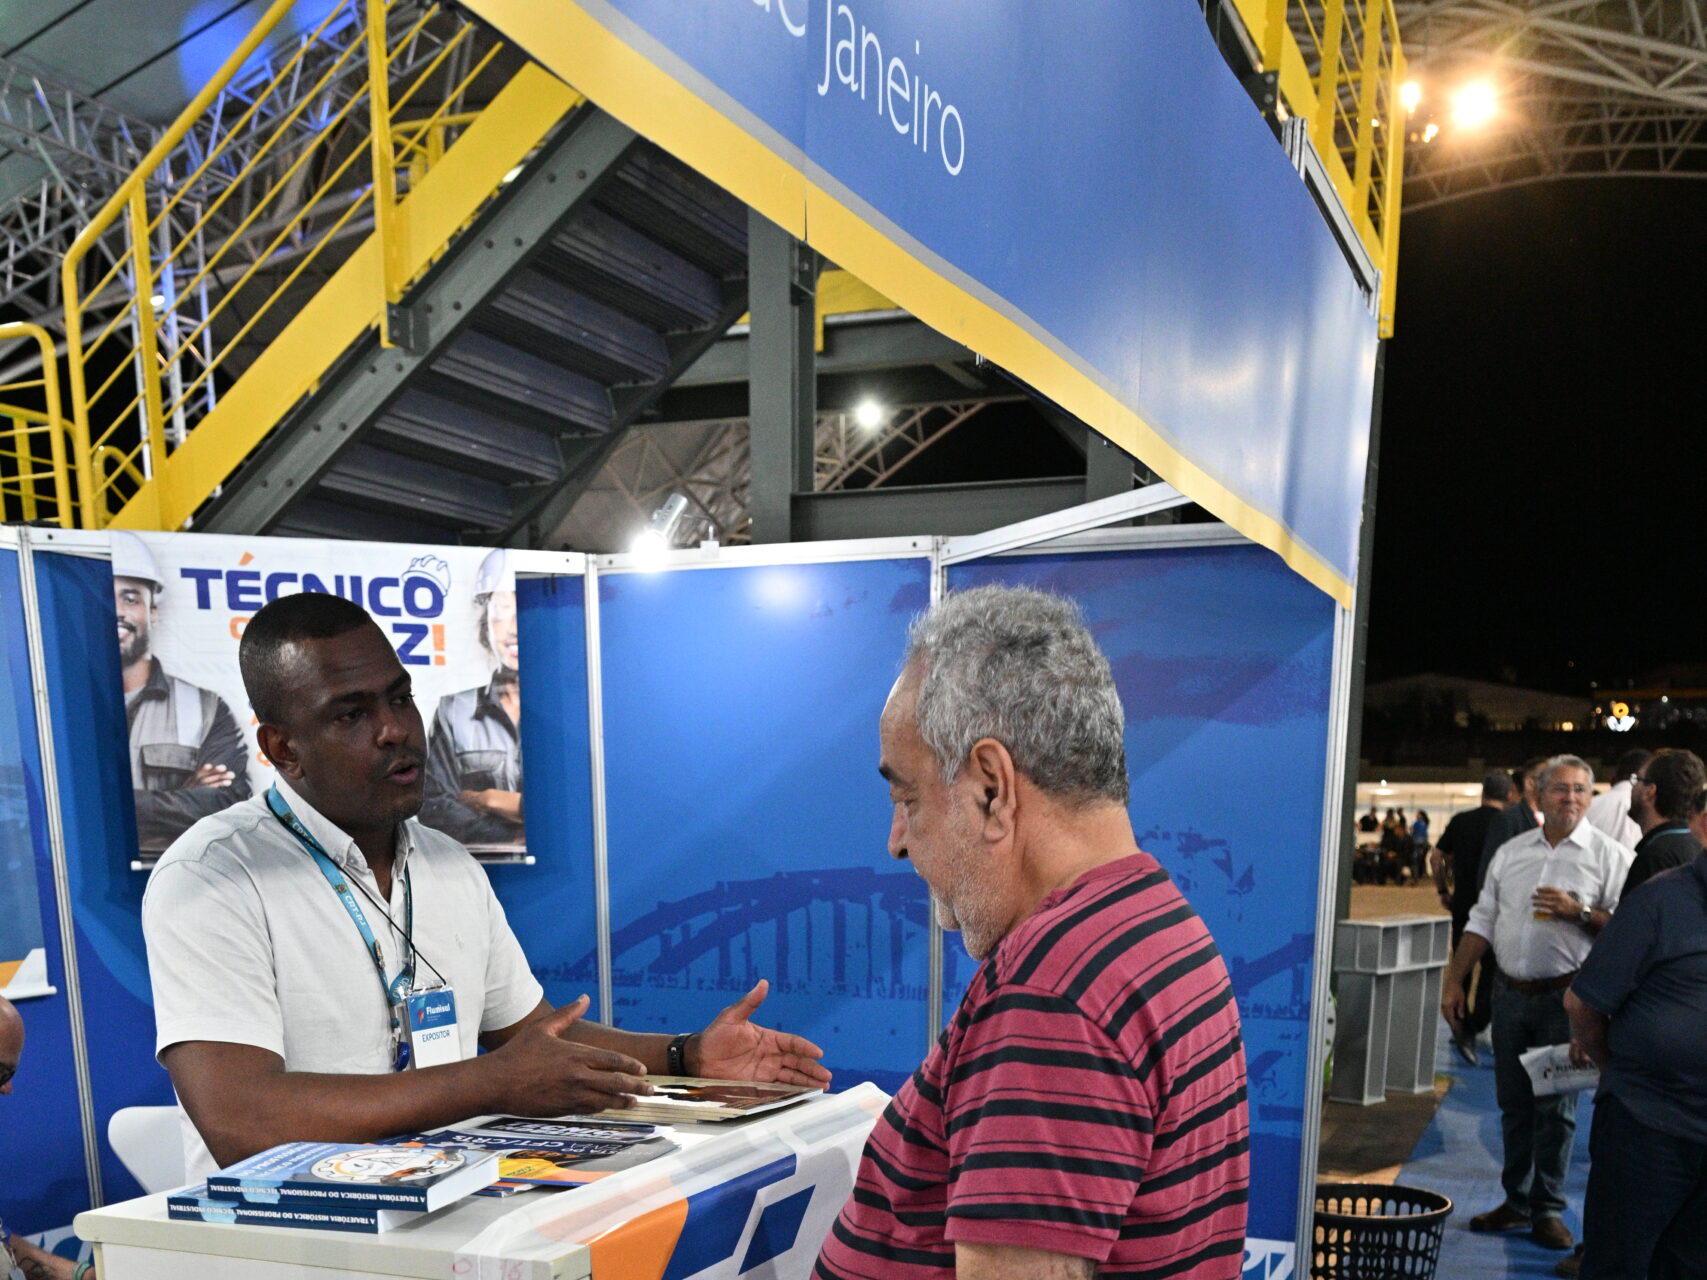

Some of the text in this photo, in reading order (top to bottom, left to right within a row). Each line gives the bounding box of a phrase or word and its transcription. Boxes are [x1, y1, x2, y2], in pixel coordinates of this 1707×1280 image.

[817, 0, 965, 176] Janeiro
[422, 1029, 451, 1043] EXPOSITOR
[209, 1184, 248, 1193] INDUSTRIAL
[280, 1188, 327, 1197] PROFISSIONAL
[329, 1191, 340, 1199] DO
[340, 1192, 377, 1201] HISTÓRICA
[378, 1194, 419, 1203] TRAJETÓRIA
[169, 1204, 205, 1213] INDUSTRIAL
[236, 1209, 281, 1219] PROFISSIONAL
[293, 1213, 329, 1222] HISTÓRICA
[329, 1216, 369, 1225] TRAJETÓRIA
